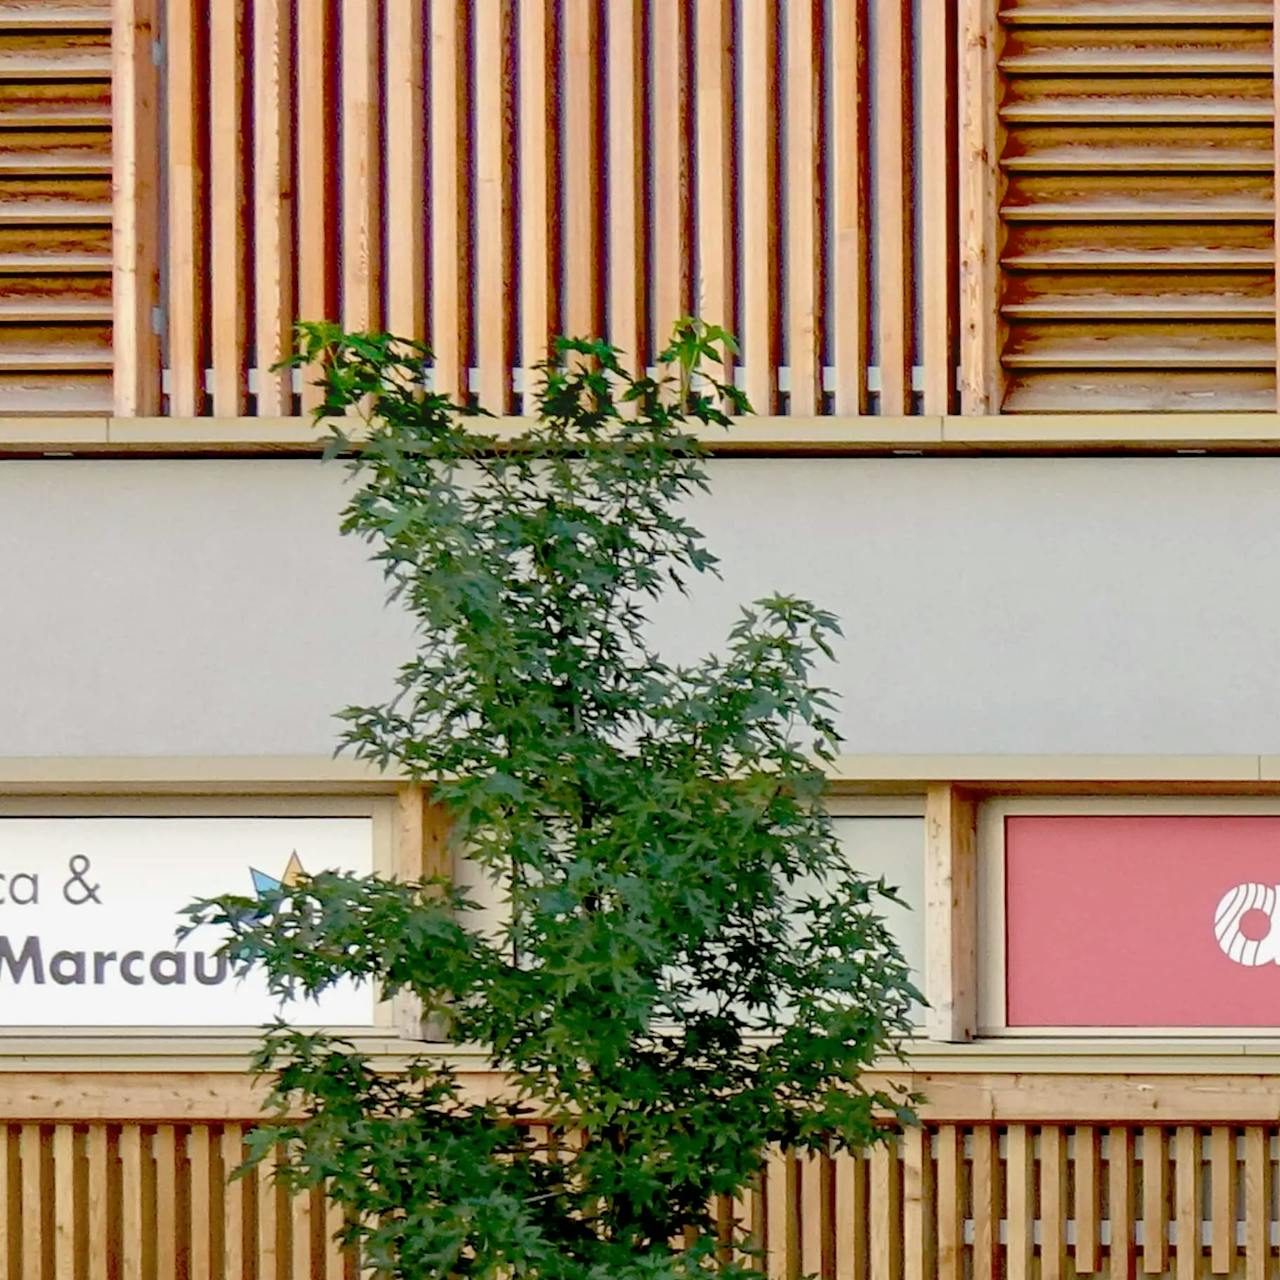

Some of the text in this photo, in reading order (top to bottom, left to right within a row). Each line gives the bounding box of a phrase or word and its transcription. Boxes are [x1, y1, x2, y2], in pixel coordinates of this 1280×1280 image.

[0, 853, 103, 906] a &
[0, 935, 229, 986] Marcau
